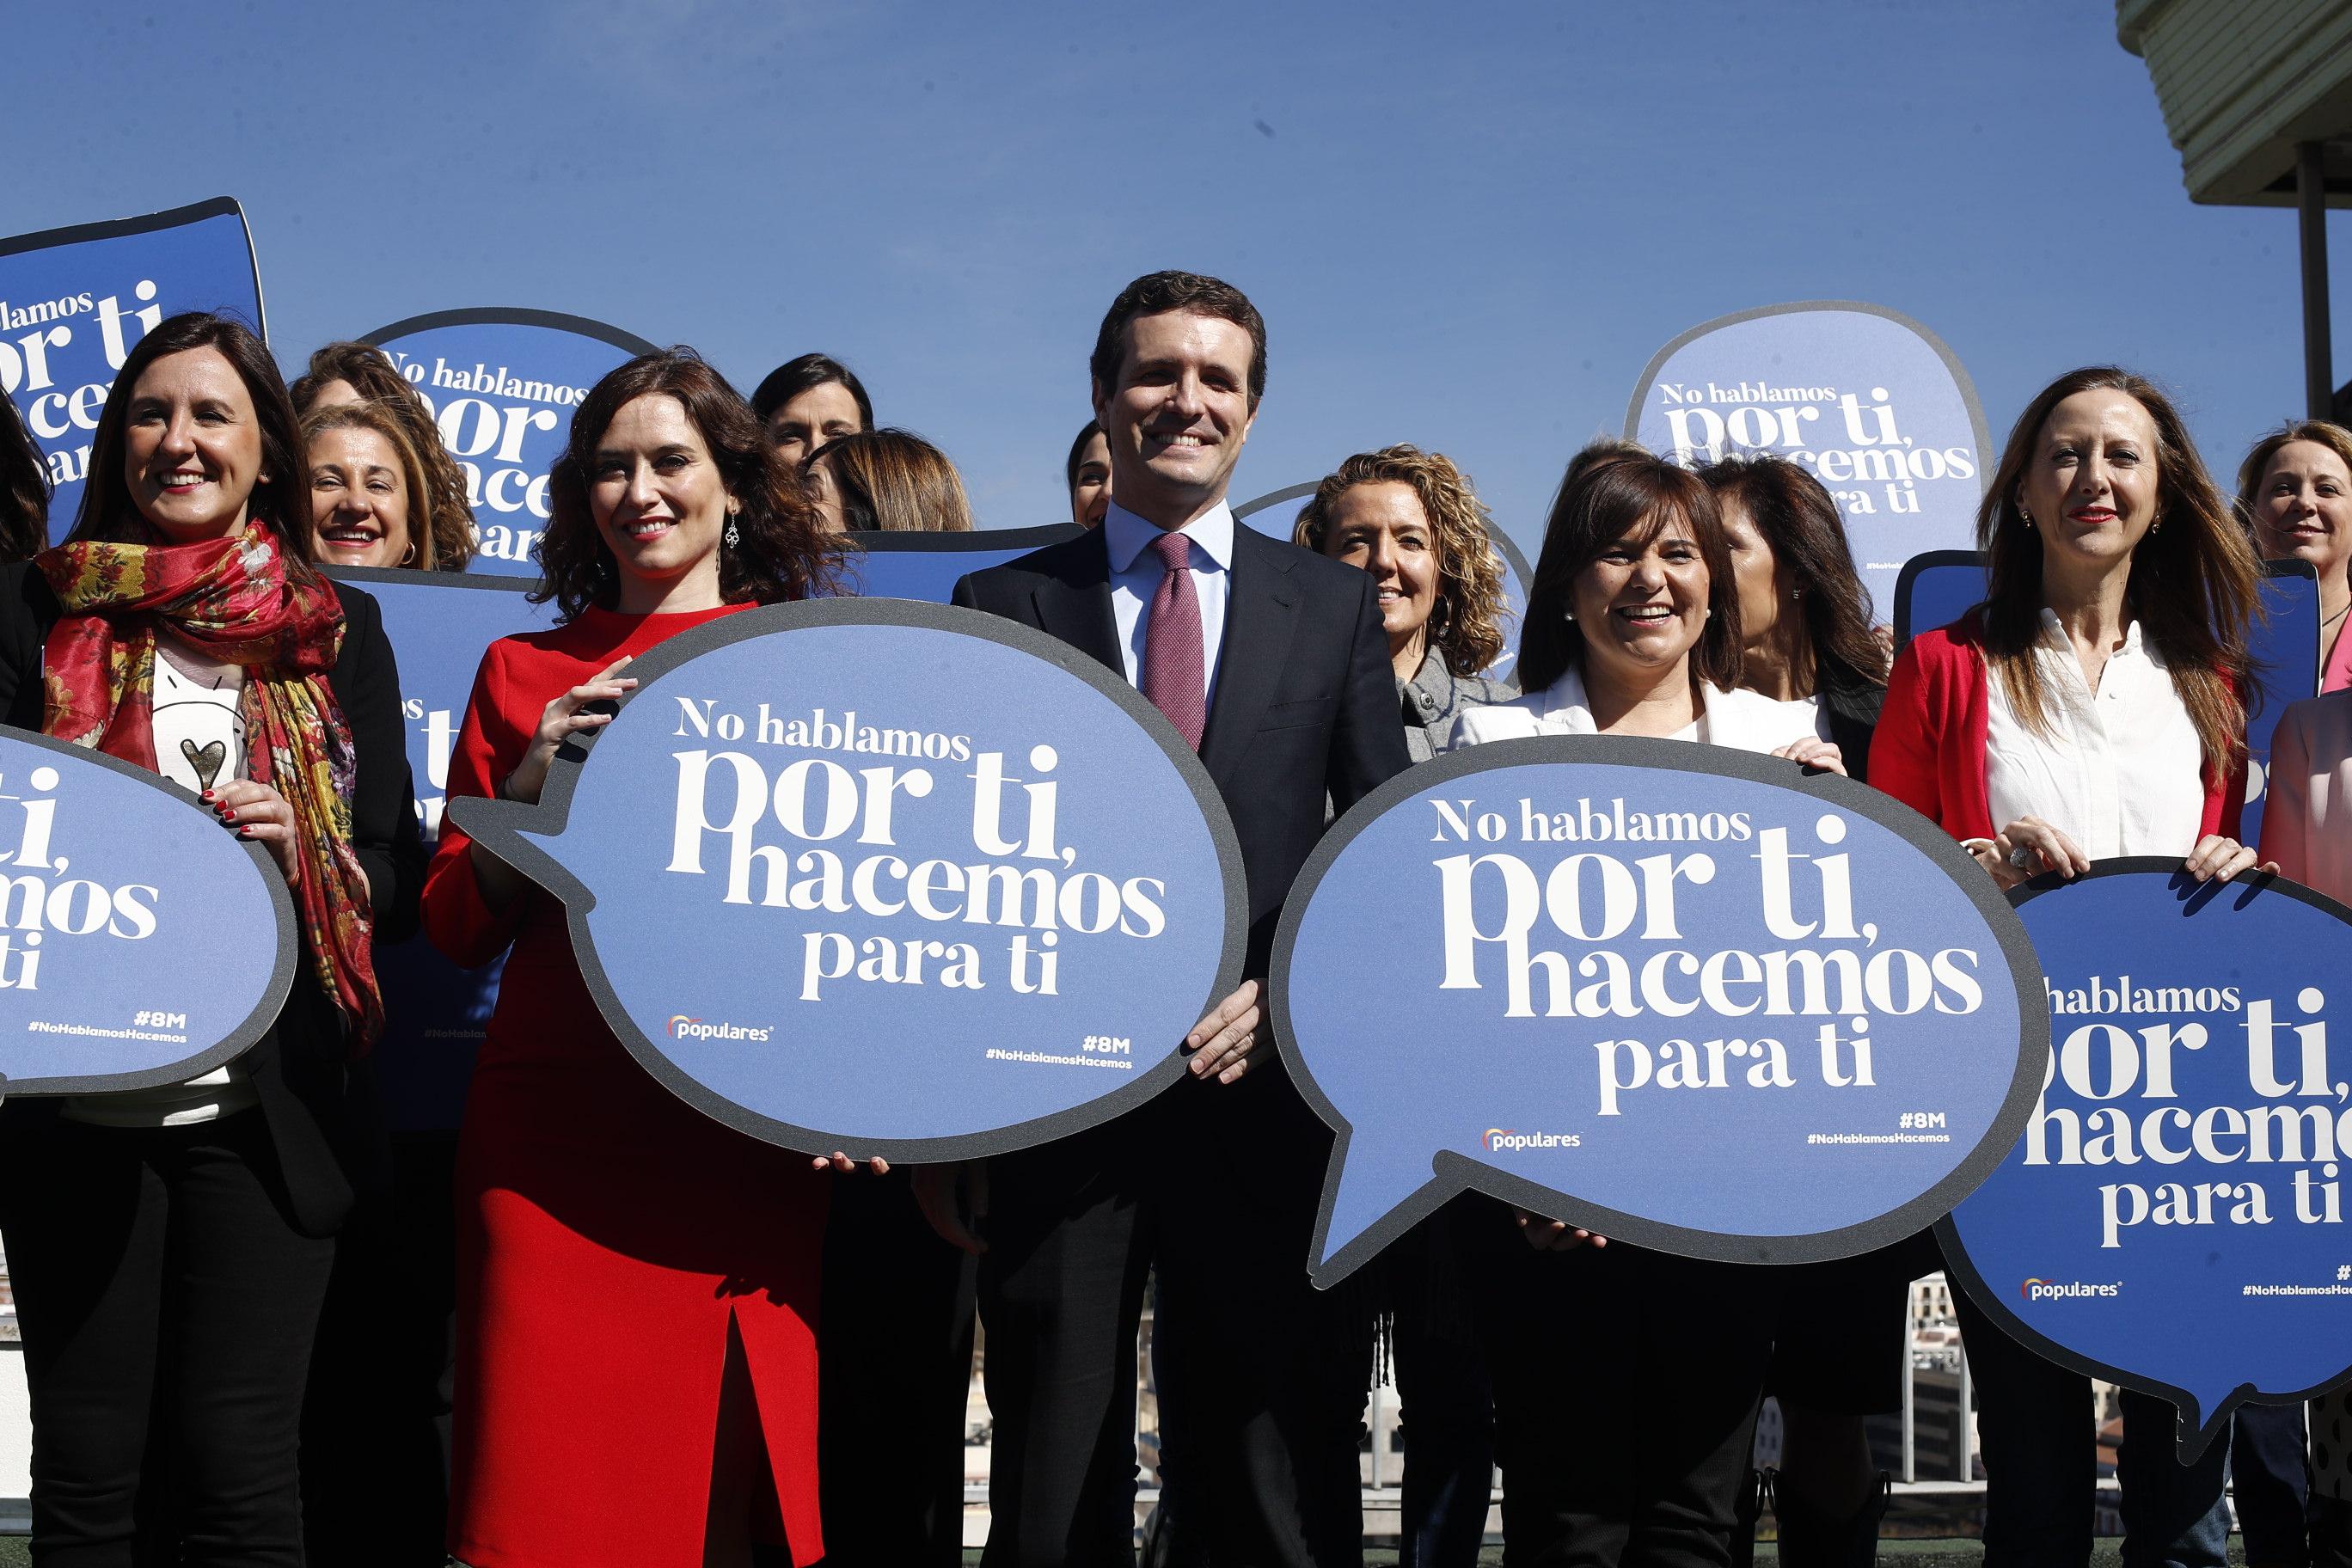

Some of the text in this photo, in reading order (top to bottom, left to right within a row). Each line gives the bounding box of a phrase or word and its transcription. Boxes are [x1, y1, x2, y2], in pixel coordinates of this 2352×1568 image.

[0, 292, 94, 331] lamos
[431, 358, 591, 408] hablamos
[1658, 382, 1837, 405] No hablamos
[413, 389, 558, 463] or
[1663, 387, 1913, 470] por ti,
[1884, 480, 1921, 514] ti
[672, 696, 971, 763] No hablamos
[665, 744, 1077, 874] por ti,
[1428, 797, 1751, 842] No hablamos
[722, 821, 1167, 939] hacemos
[1432, 813, 1879, 989] por ti,
[799, 930, 1060, 1001] para ti
[1504, 928, 1983, 1019] hacemos
[2043, 975, 2241, 1014] hablamos
[28, 1020, 188, 1044] #NoHablamosHacemos
[133, 1010, 187, 1030] #8M
[1081, 1034, 1131, 1055] #8M
[985, 1048, 1133, 1069] #NoHablamosHacemos
[1593, 1015, 1877, 1116] para ti
[2041, 987, 2350, 1105] or ti,
[1492, 1131, 1581, 1152] populares
[1806, 1132, 1951, 1144] #NoHablamosHacemos
[1899, 1112, 1946, 1129] #8M
[2022, 1090, 2352, 1166] hacem
[2098, 1163, 2343, 1248] para ti
